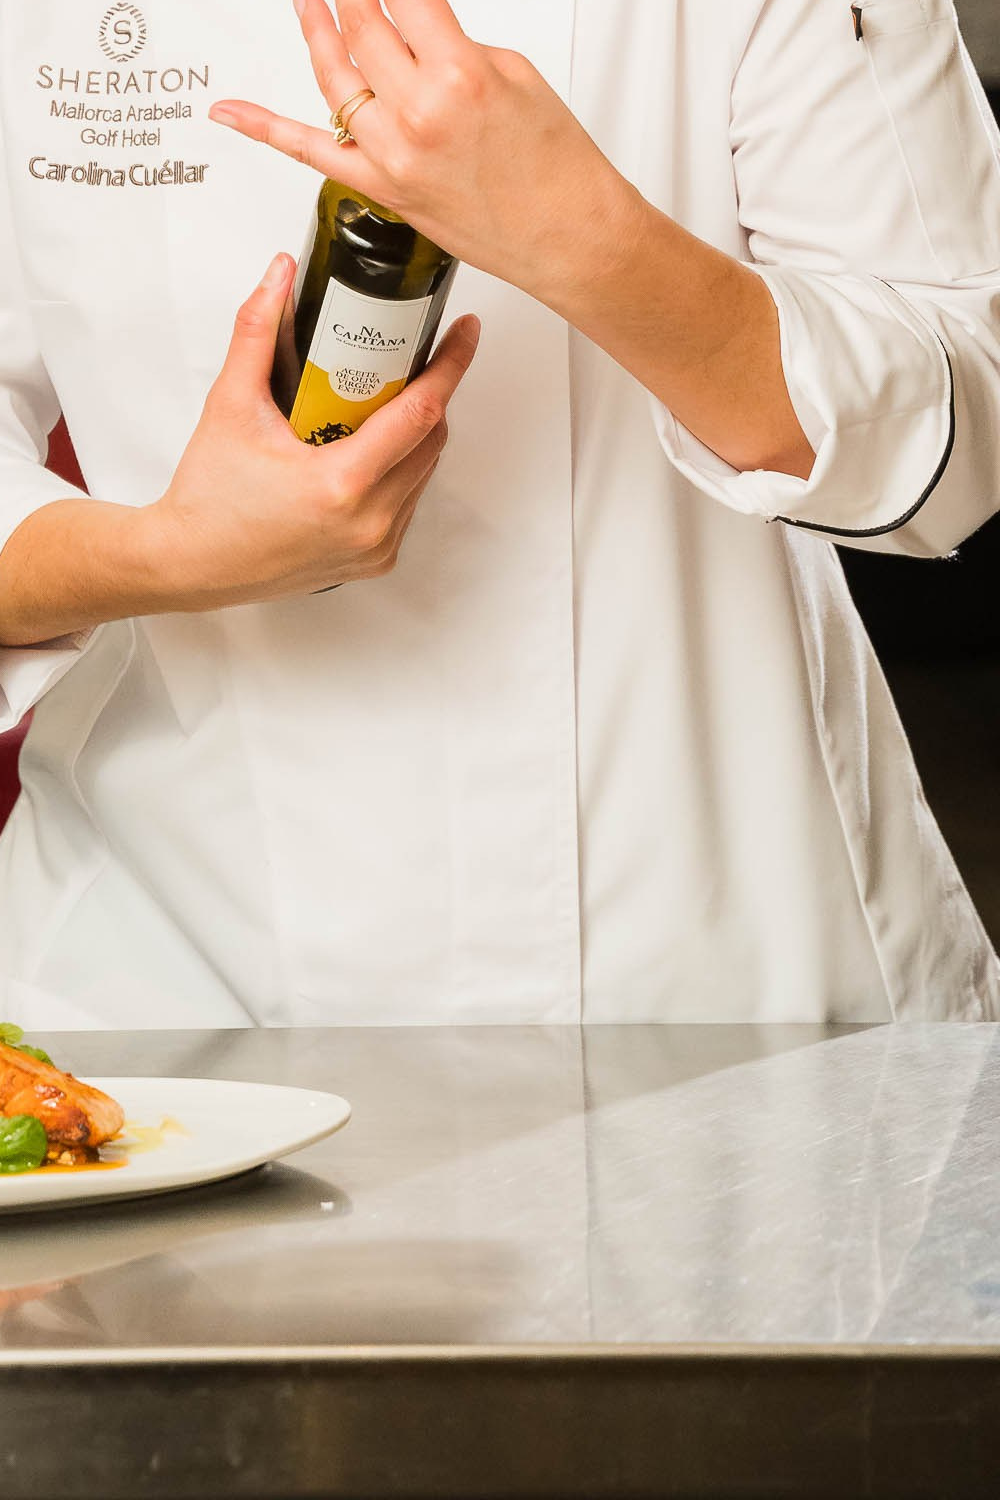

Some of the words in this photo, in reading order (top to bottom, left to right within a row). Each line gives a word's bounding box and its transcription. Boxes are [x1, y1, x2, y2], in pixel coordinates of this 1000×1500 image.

[113, 19, 132, 45] S
[36, 64, 209, 95] SHERATON
[50, 100, 122, 122] Mallorca
[126, 101, 192, 122] Arabella
[80, 128, 119, 147] Golf
[122, 127, 161, 148] Hotel
[28, 156, 126, 187] Carolina
[128, 159, 209, 187] Cuéllar
[332, 324, 406, 346] CAPITANA
[335, 370, 349, 380] DE
[351, 375, 380, 384] OLIVA
[341, 367, 378, 378] ACEITE
[337, 384, 371, 395] EXTRA
[338, 378, 376, 389] VIRGEN
